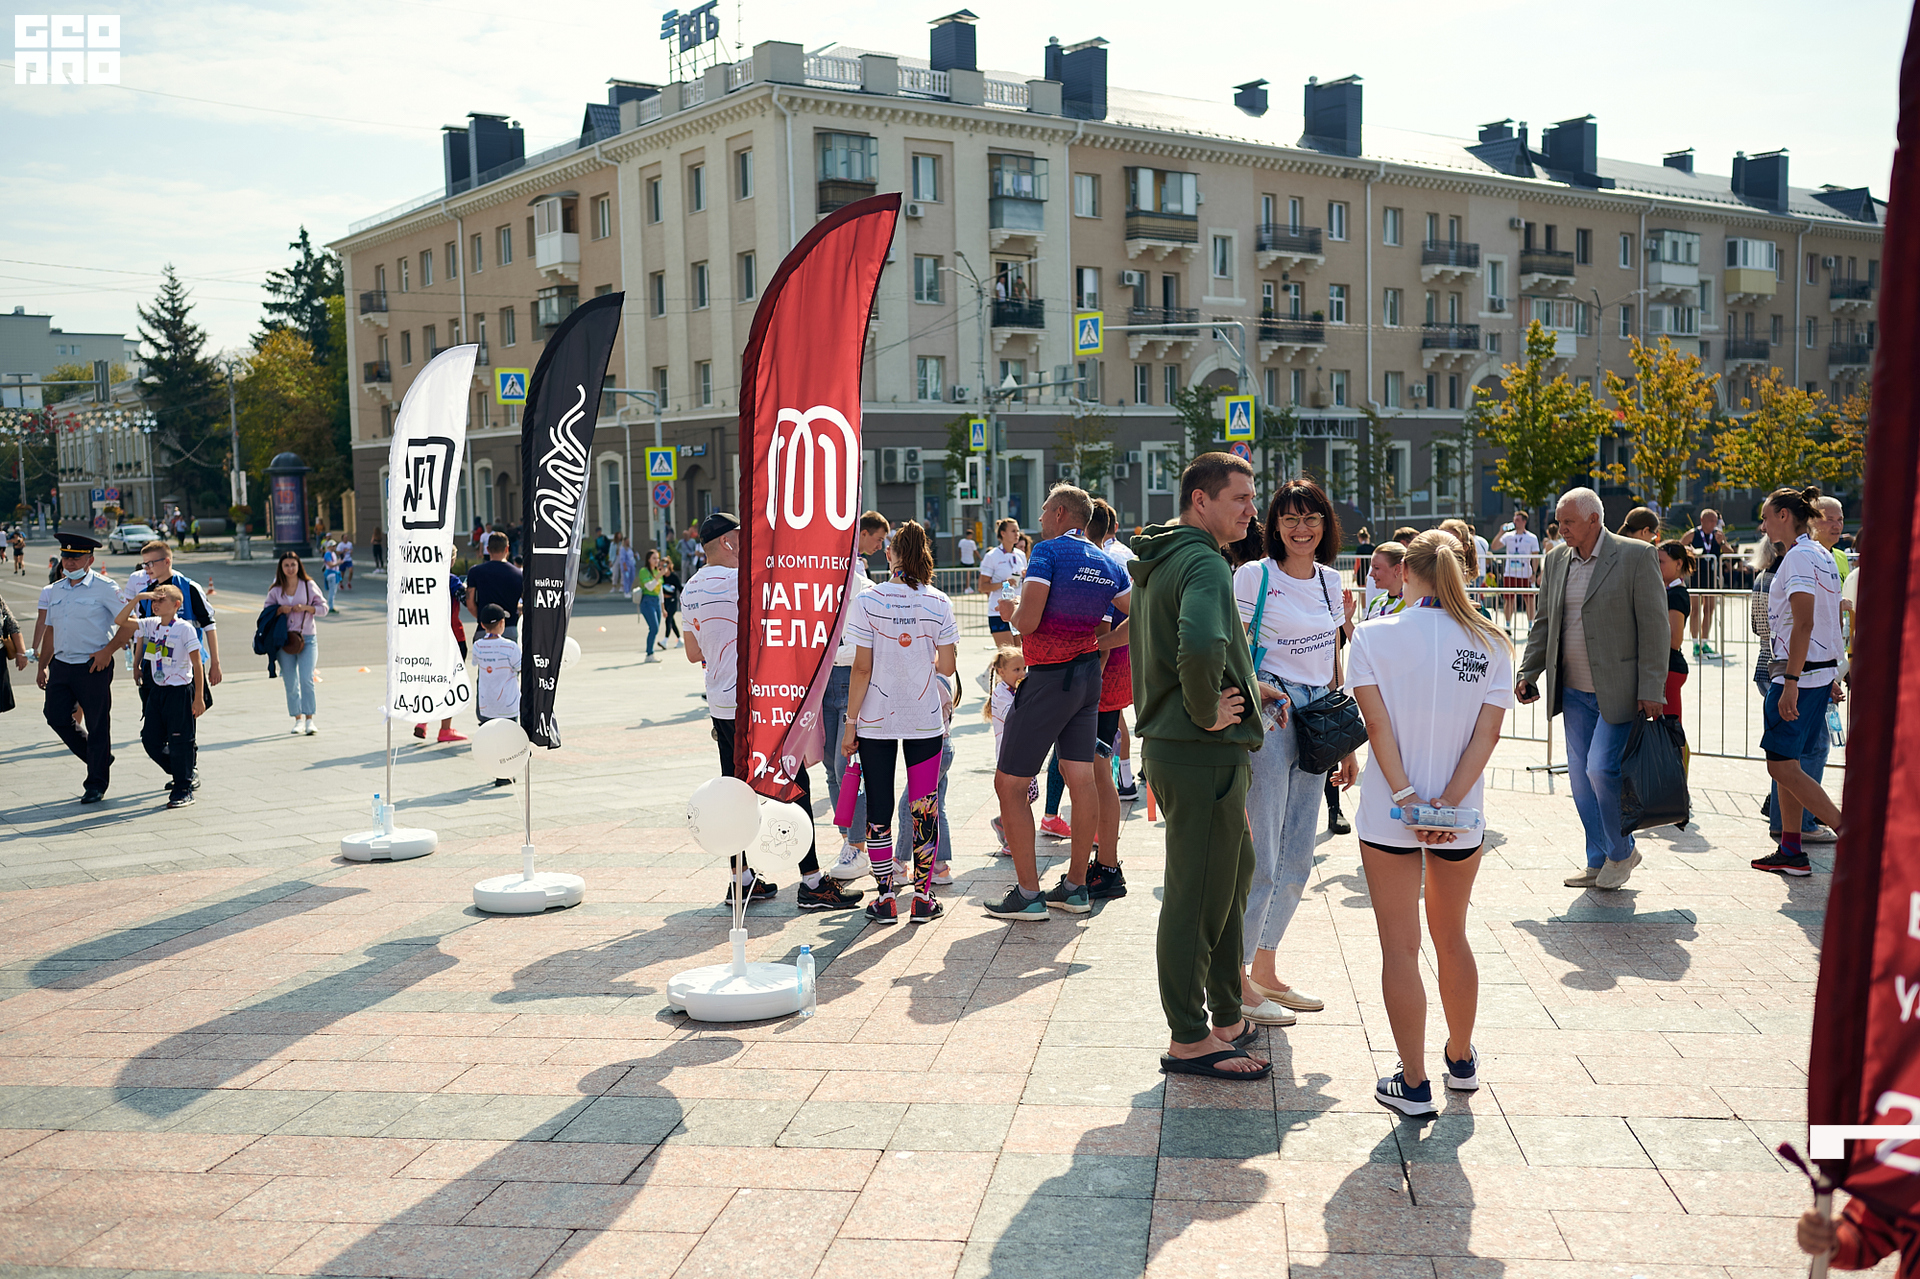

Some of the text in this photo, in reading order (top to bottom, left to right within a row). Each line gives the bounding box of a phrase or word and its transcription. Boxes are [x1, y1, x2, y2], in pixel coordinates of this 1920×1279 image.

[679, 0, 720, 53] ВТБ
[1078, 566, 1102, 576] #ВСЕ
[1456, 649, 1487, 660] VOBLA
[1458, 671, 1480, 683] RUN
